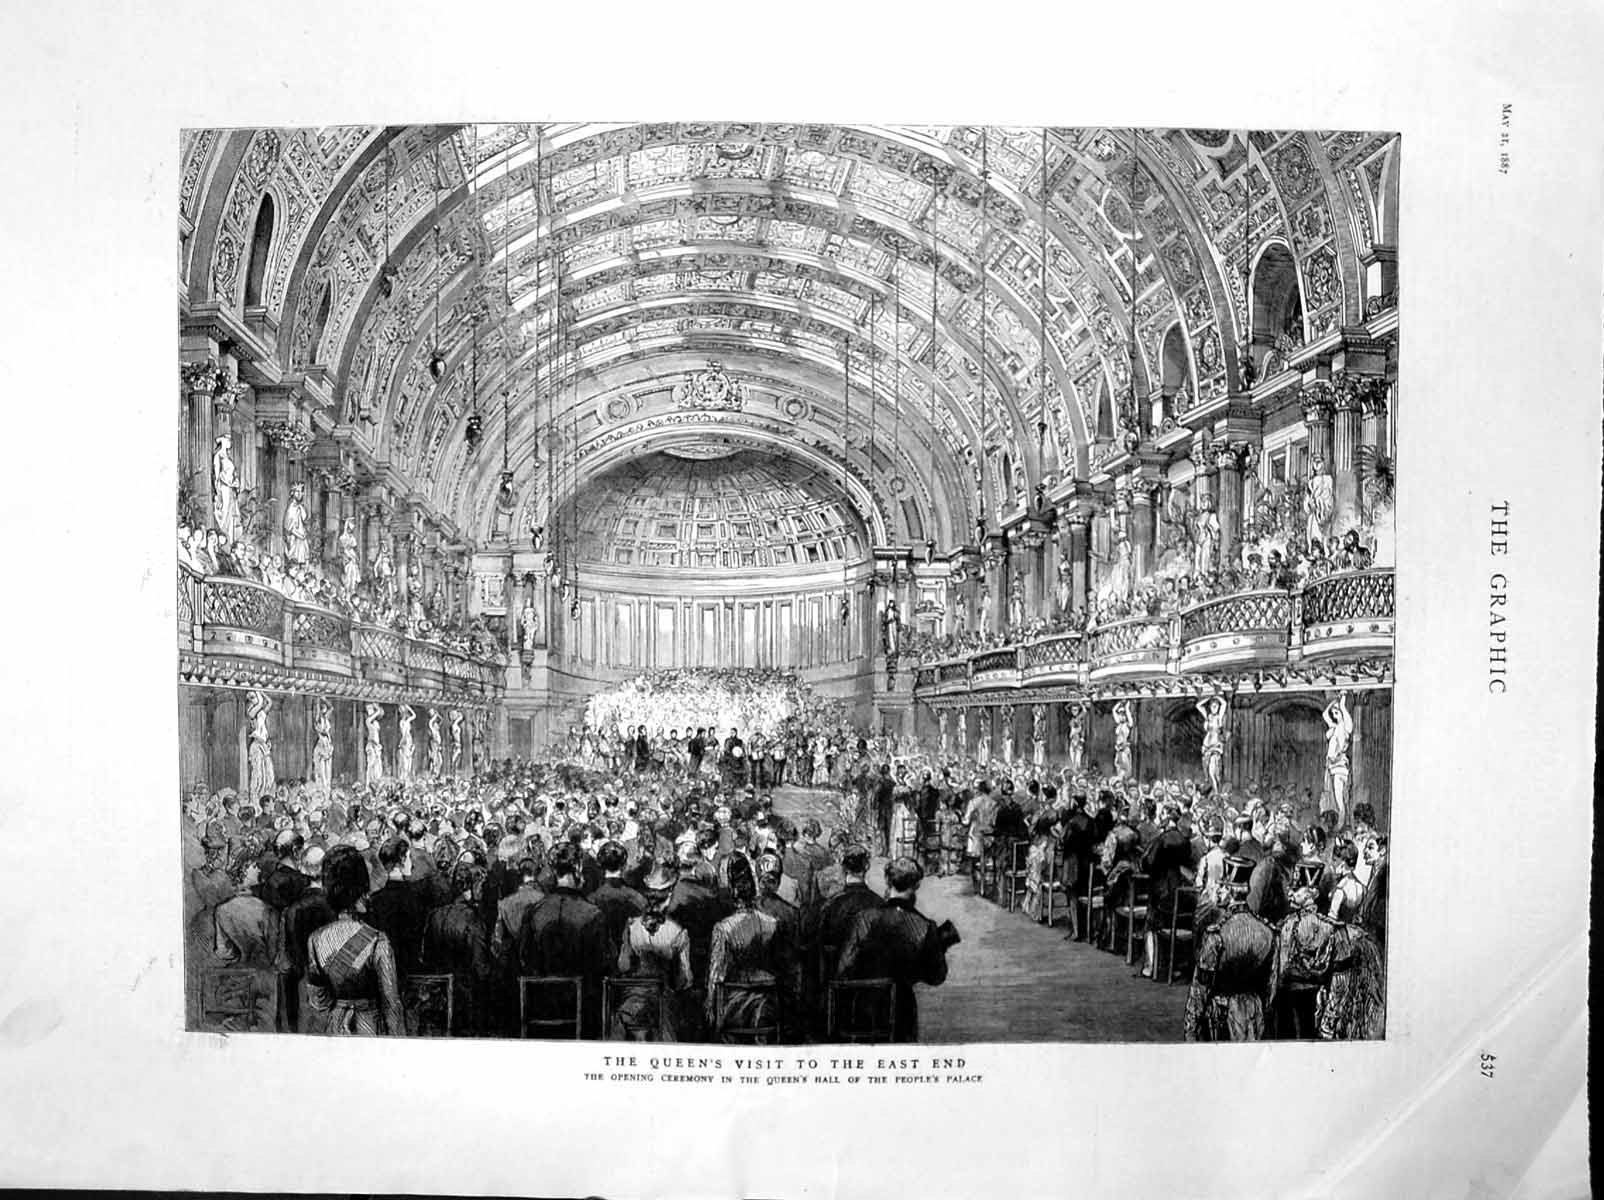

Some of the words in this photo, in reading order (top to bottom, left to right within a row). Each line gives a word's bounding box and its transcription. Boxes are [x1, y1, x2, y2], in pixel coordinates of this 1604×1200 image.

[1490, 500, 1509, 556] THE
[1489, 573, 1507, 694] GRAPHIC
[604, 1056, 637, 1066] THE
[649, 1057, 722, 1070] QUEEN'S
[735, 1058, 782, 1069] VISIT
[797, 1058, 818, 1069] TO
[830, 1059, 864, 1069] THE
[877, 1059, 919, 1069] EAST
[932, 1058, 966, 1069] END
[1480, 1053, 1497, 1079] 537
[584, 1073, 604, 1081] THE
[610, 1073, 654, 1082] OPENING
[660, 1074, 714, 1083] CEREMONY
[721, 1075, 732, 1083] IN
[740, 1075, 758, 1083] THE
[766, 1075, 807, 1086] QUEEN'S
[814, 1075, 839, 1084] HALL
[847, 1075, 860, 1084] OF
[867, 1075, 887, 1084] THE
[895, 1075, 939, 1084] PEOPLE'S
[946, 1075, 982, 1083] PALACE
